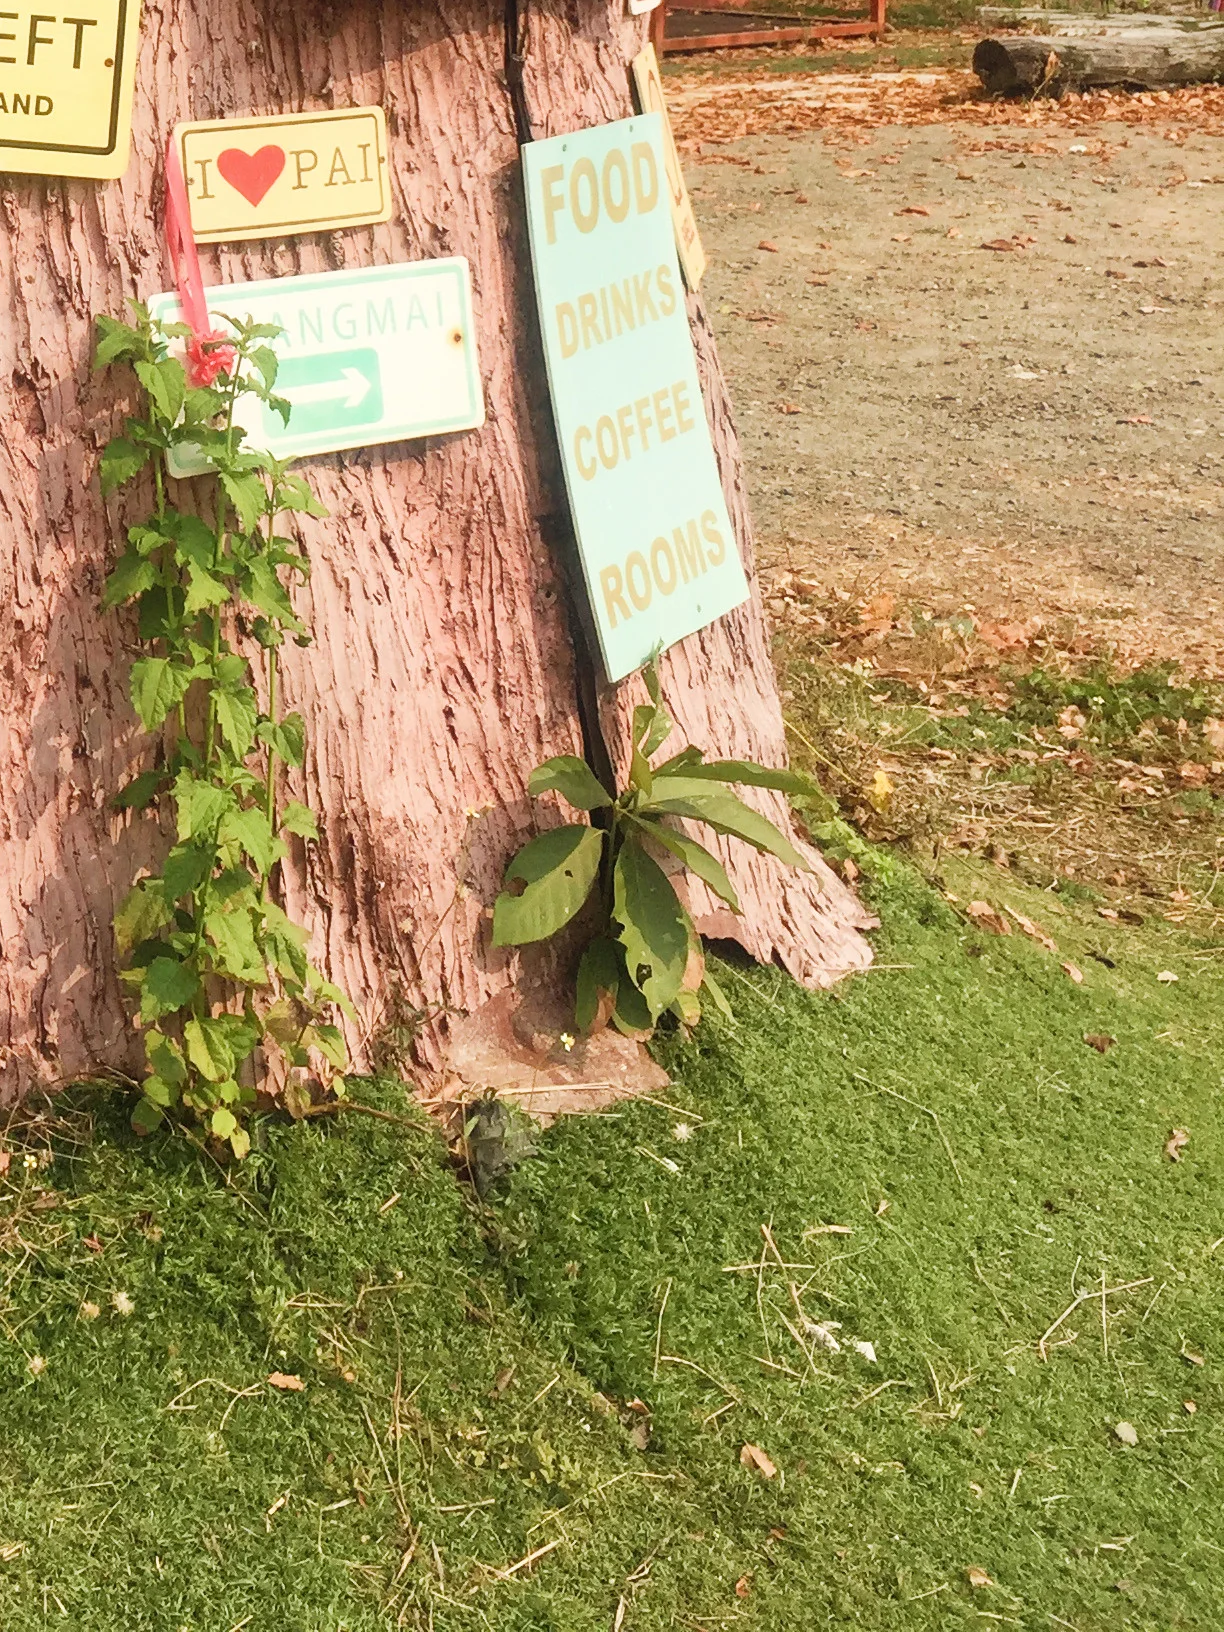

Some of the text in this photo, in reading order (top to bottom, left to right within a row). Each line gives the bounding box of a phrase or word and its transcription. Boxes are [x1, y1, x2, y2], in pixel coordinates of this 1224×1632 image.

[193, 143, 374, 199] I PAI
[541, 140, 660, 246] FOOD
[555, 264, 677, 360] DRINKS
[574, 380, 695, 482] COFFEE
[599, 509, 727, 630] ROOMS
